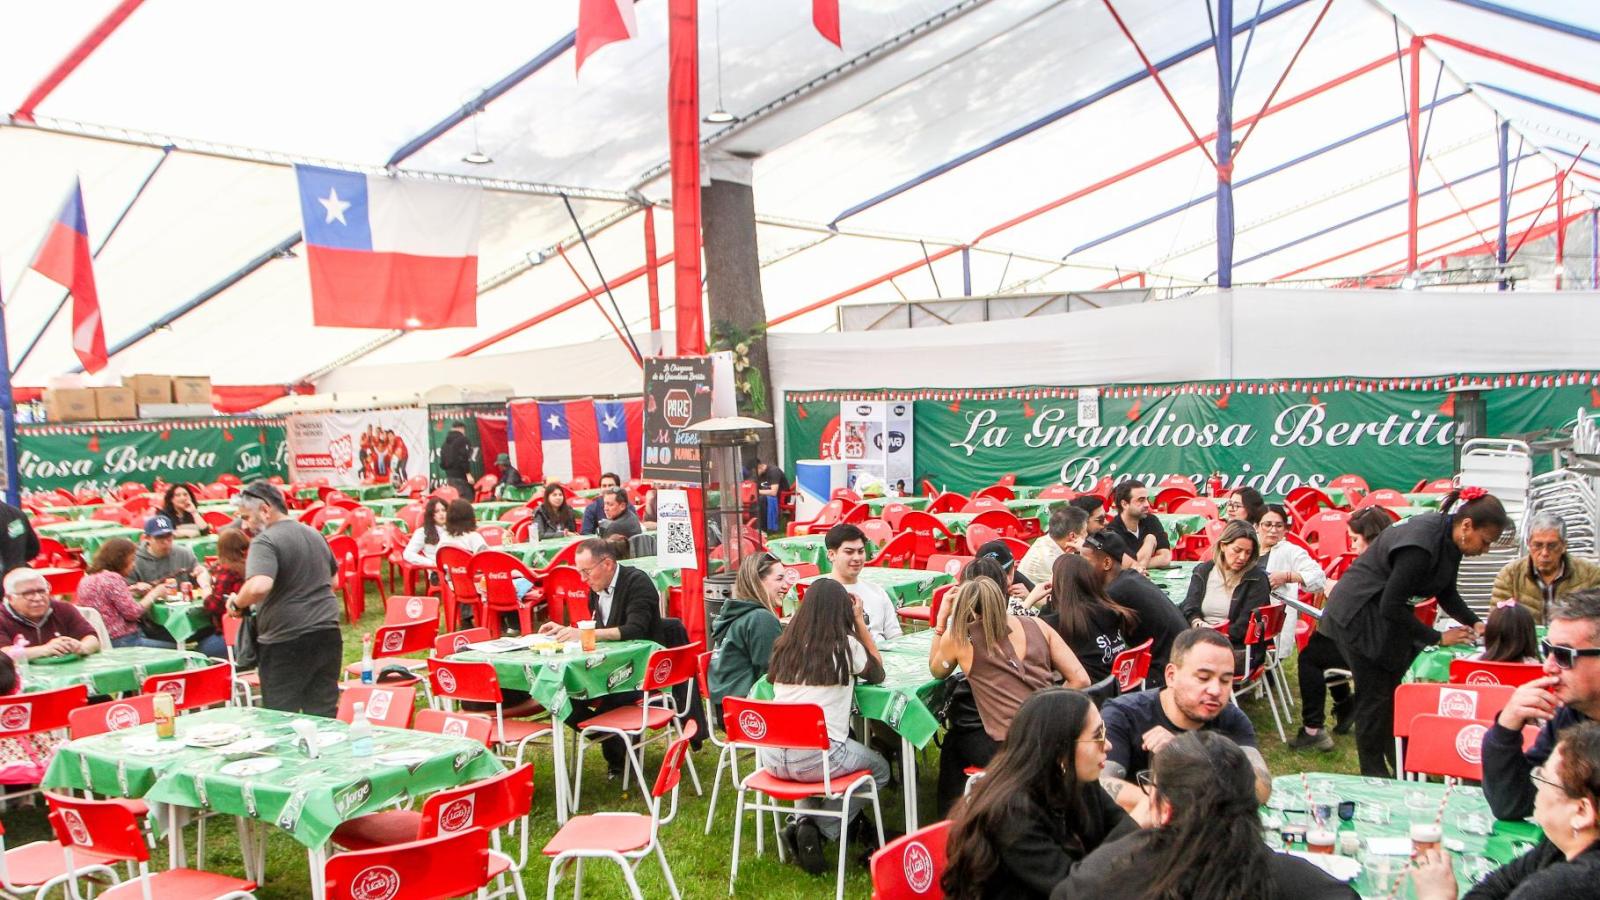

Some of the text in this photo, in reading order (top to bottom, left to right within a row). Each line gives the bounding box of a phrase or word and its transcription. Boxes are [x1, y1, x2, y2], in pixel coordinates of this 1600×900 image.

[667, 400, 689, 417] PARE
[950, 409, 1012, 456] La
[1024, 405, 1258, 448] Grandiosa
[103, 444, 218, 475] Bertita
[646, 446, 671, 465] NO
[1060, 456, 1325, 496] Benenidos
